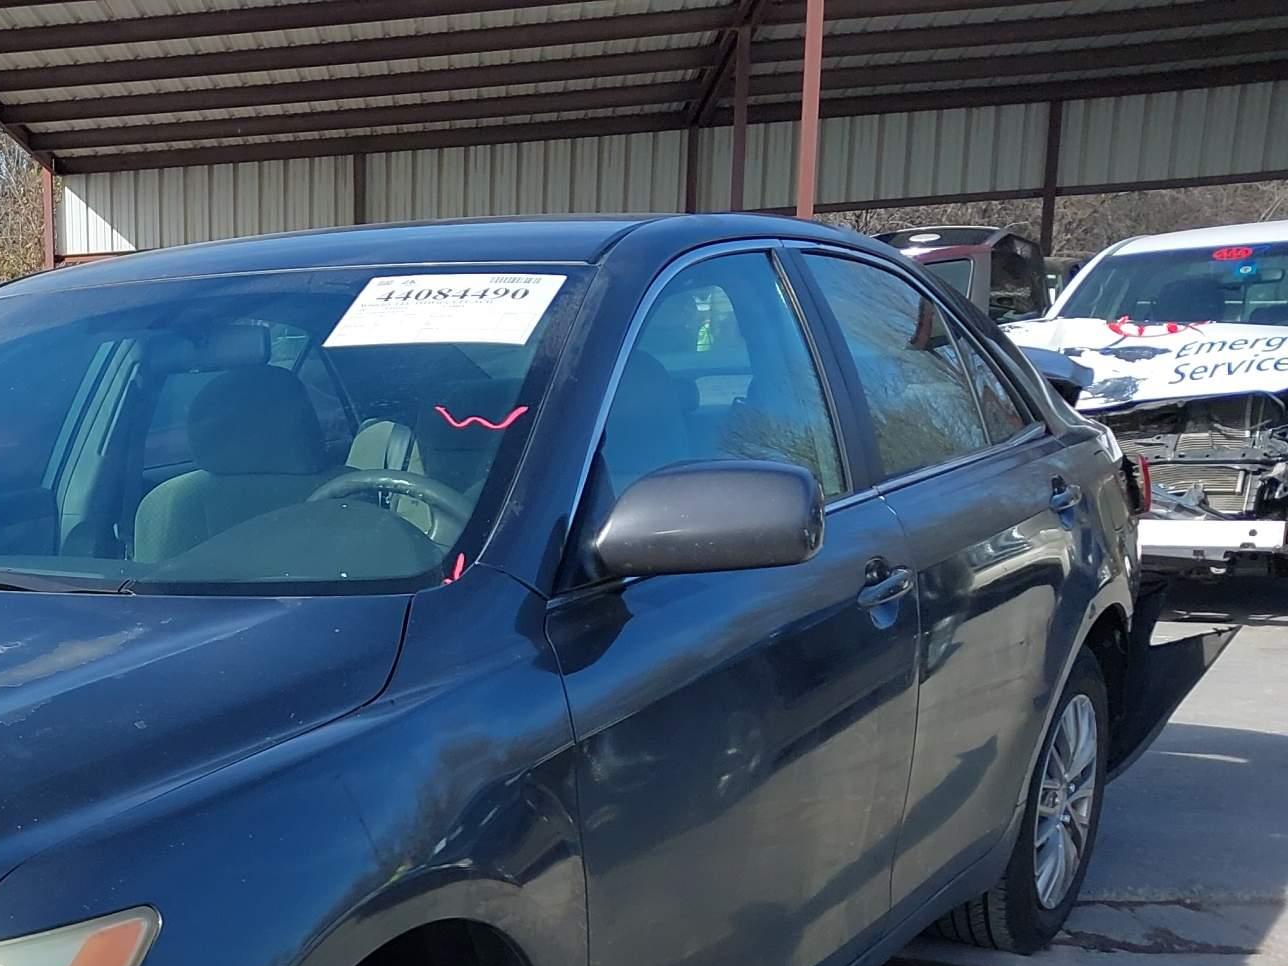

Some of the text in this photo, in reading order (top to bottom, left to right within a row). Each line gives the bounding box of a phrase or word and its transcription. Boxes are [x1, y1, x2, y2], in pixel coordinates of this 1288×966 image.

[376, 287, 530, 302] 44084490
[1175, 336, 1288, 359] Emerg
[1168, 354, 1288, 385] Service
